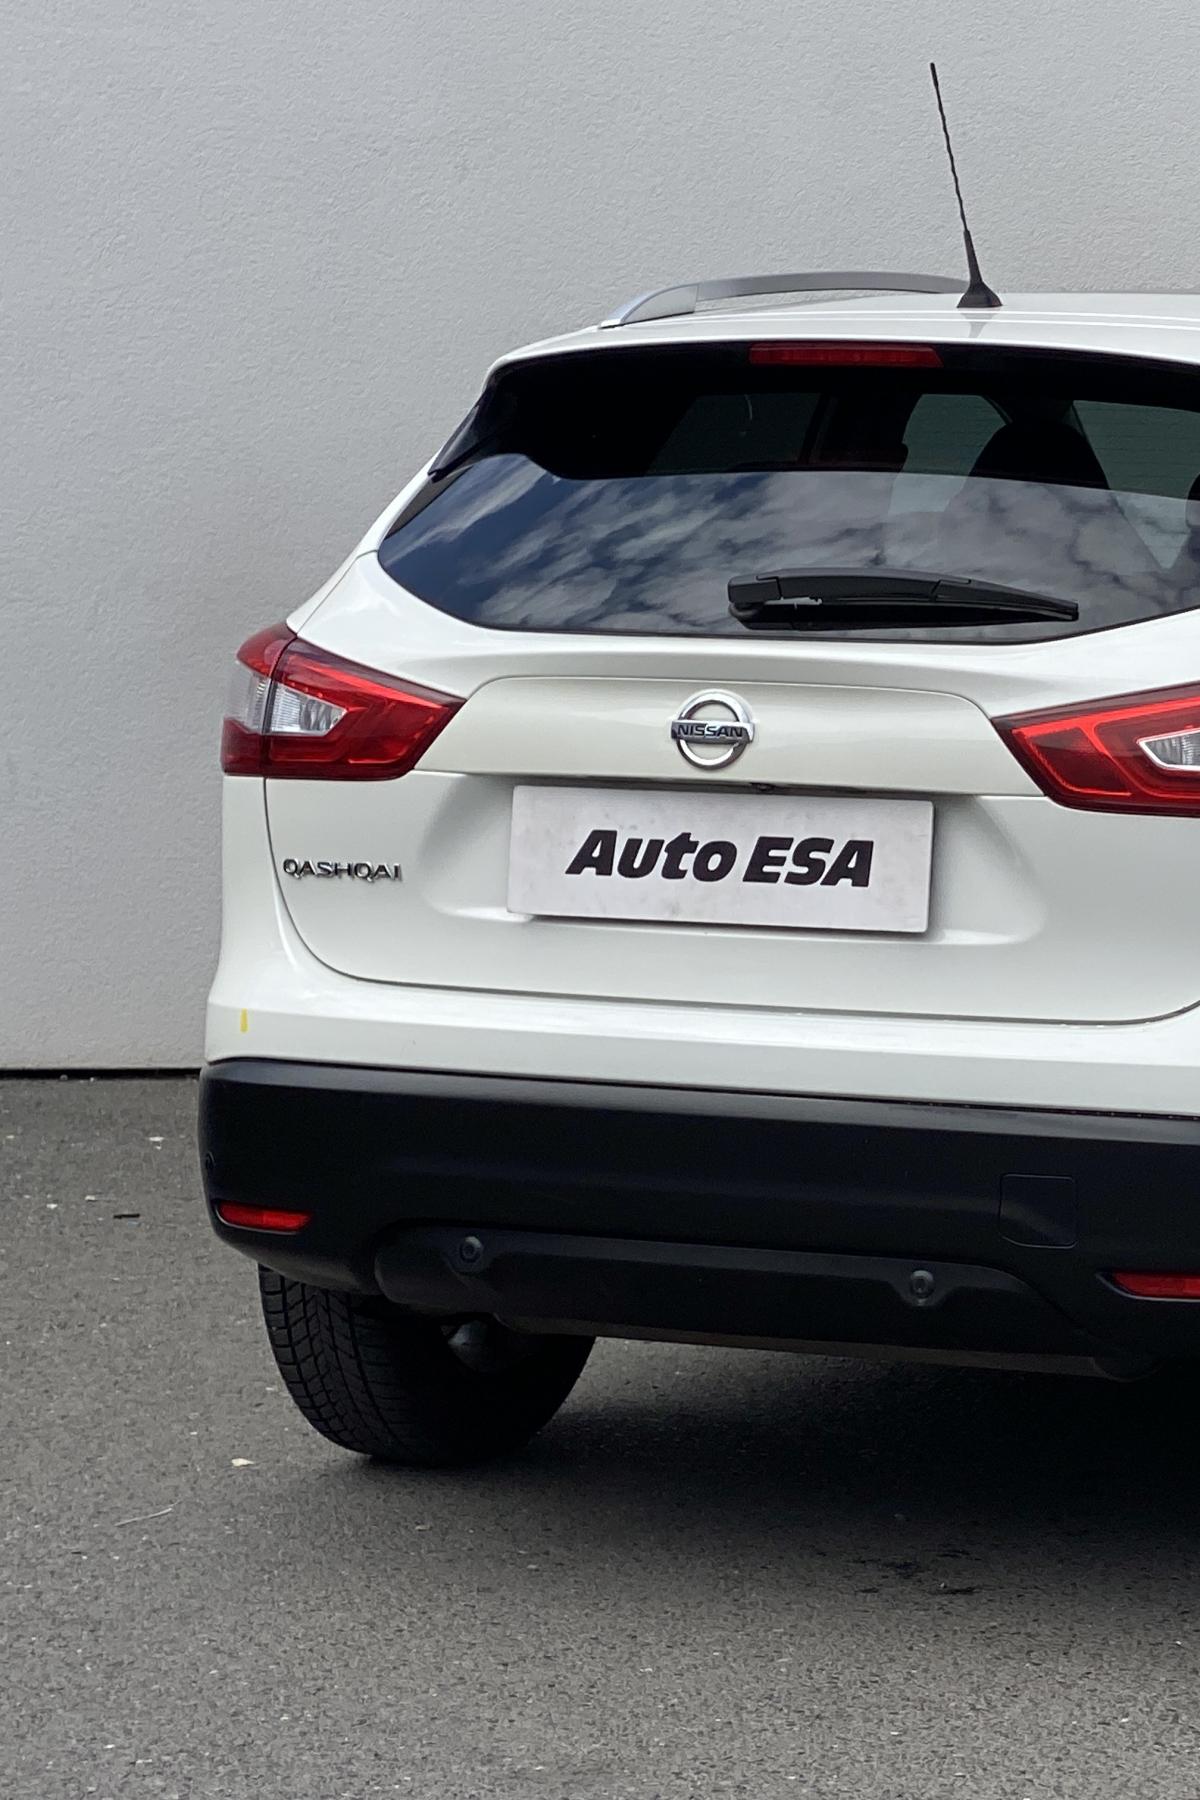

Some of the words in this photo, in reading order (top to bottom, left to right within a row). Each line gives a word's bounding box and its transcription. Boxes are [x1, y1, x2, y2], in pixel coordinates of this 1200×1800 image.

[676, 723, 744, 738] NISSAN
[282, 857, 402, 883] QASHQAI
[565, 829, 738, 882] Auto
[742, 836, 874, 888] ESA
